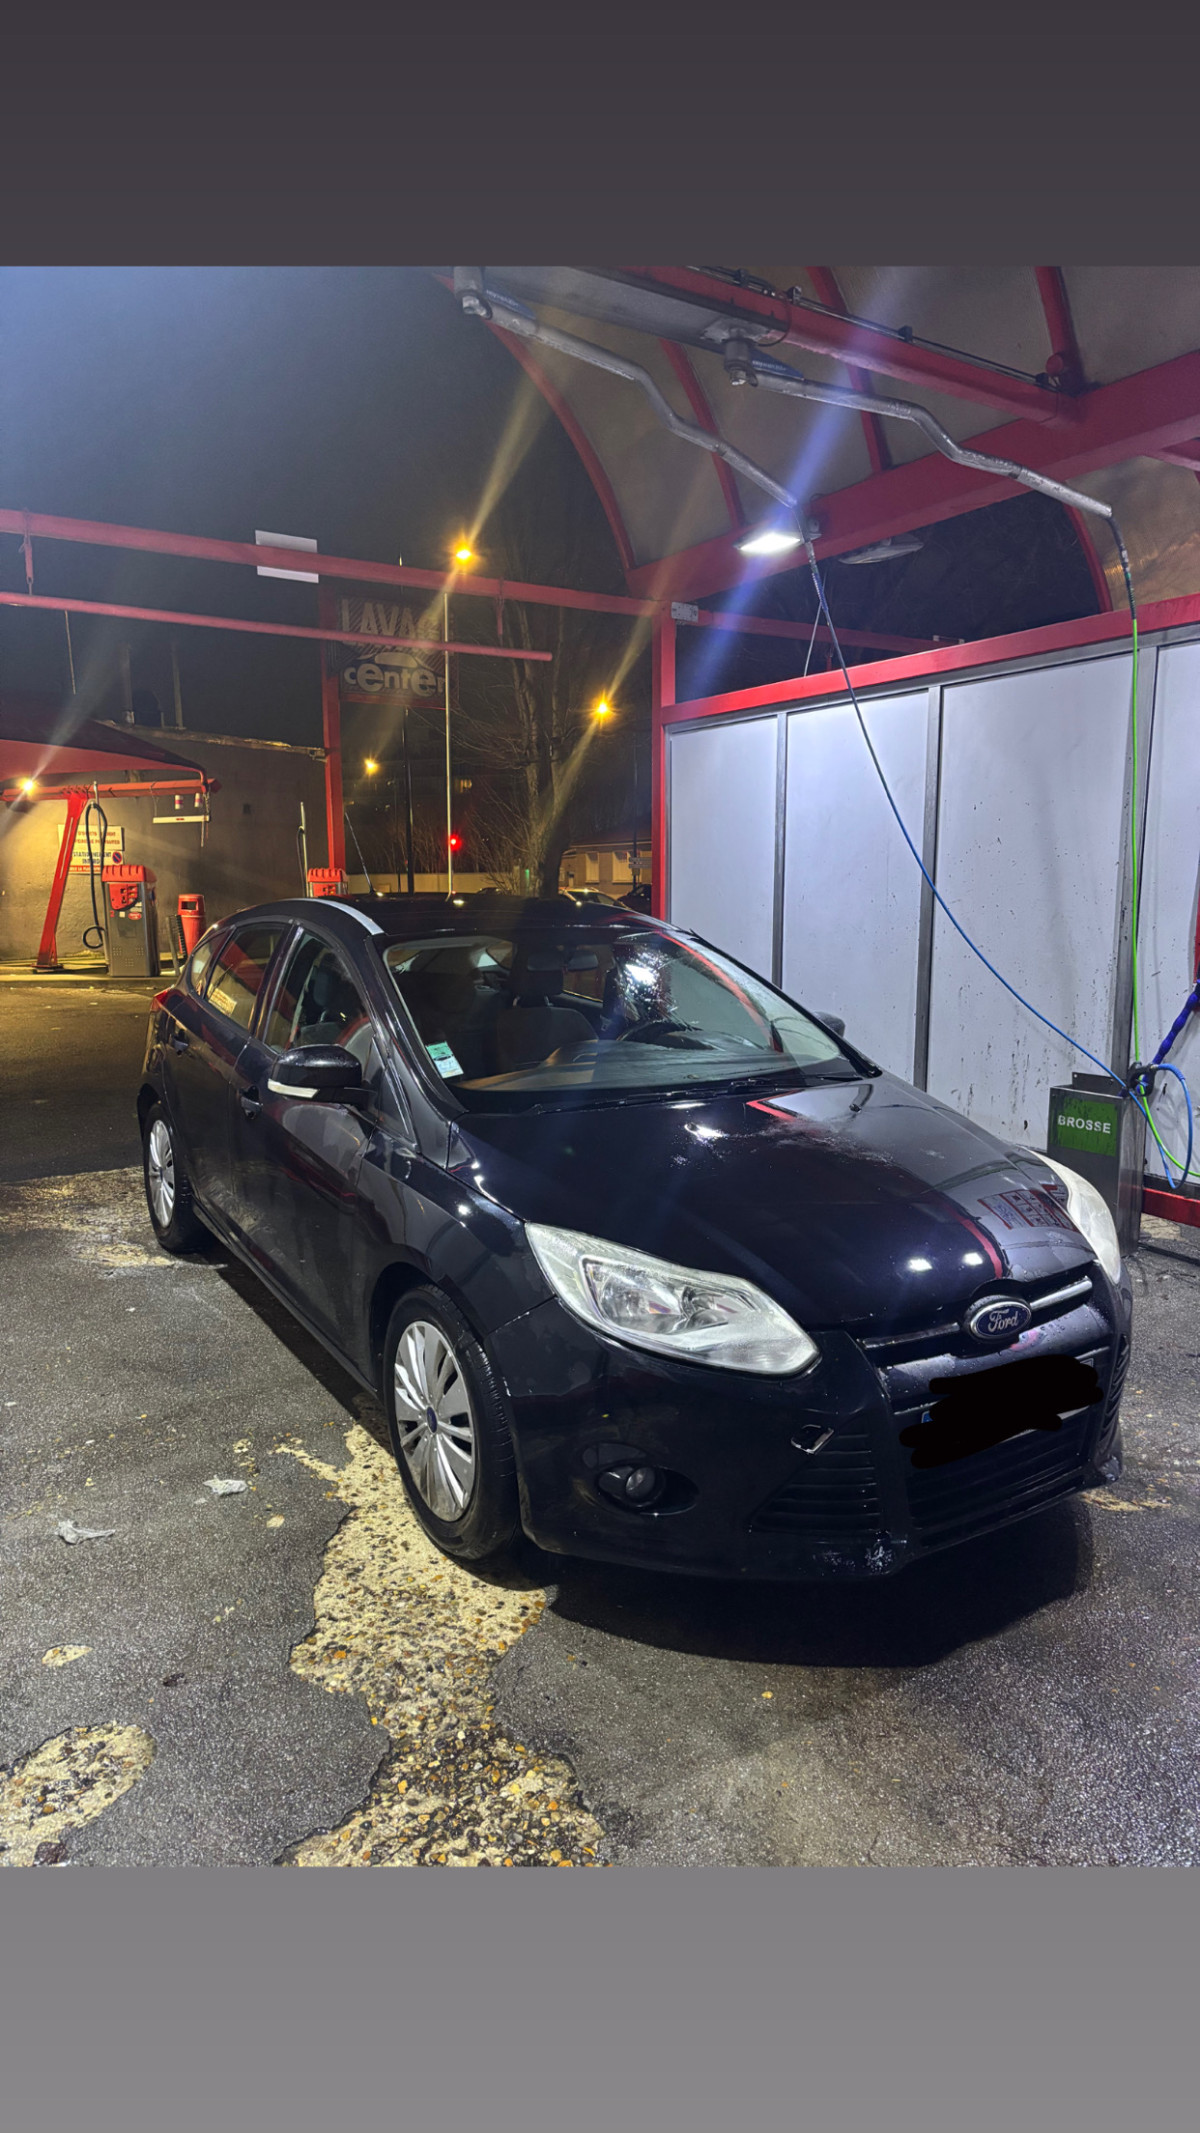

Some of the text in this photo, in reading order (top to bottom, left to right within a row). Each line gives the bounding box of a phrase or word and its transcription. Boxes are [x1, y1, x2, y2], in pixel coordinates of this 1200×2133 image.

[344, 663, 446, 697] center
[1057, 1114, 1112, 1134] BROSSE
[987, 1308, 1020, 1333] Ford
